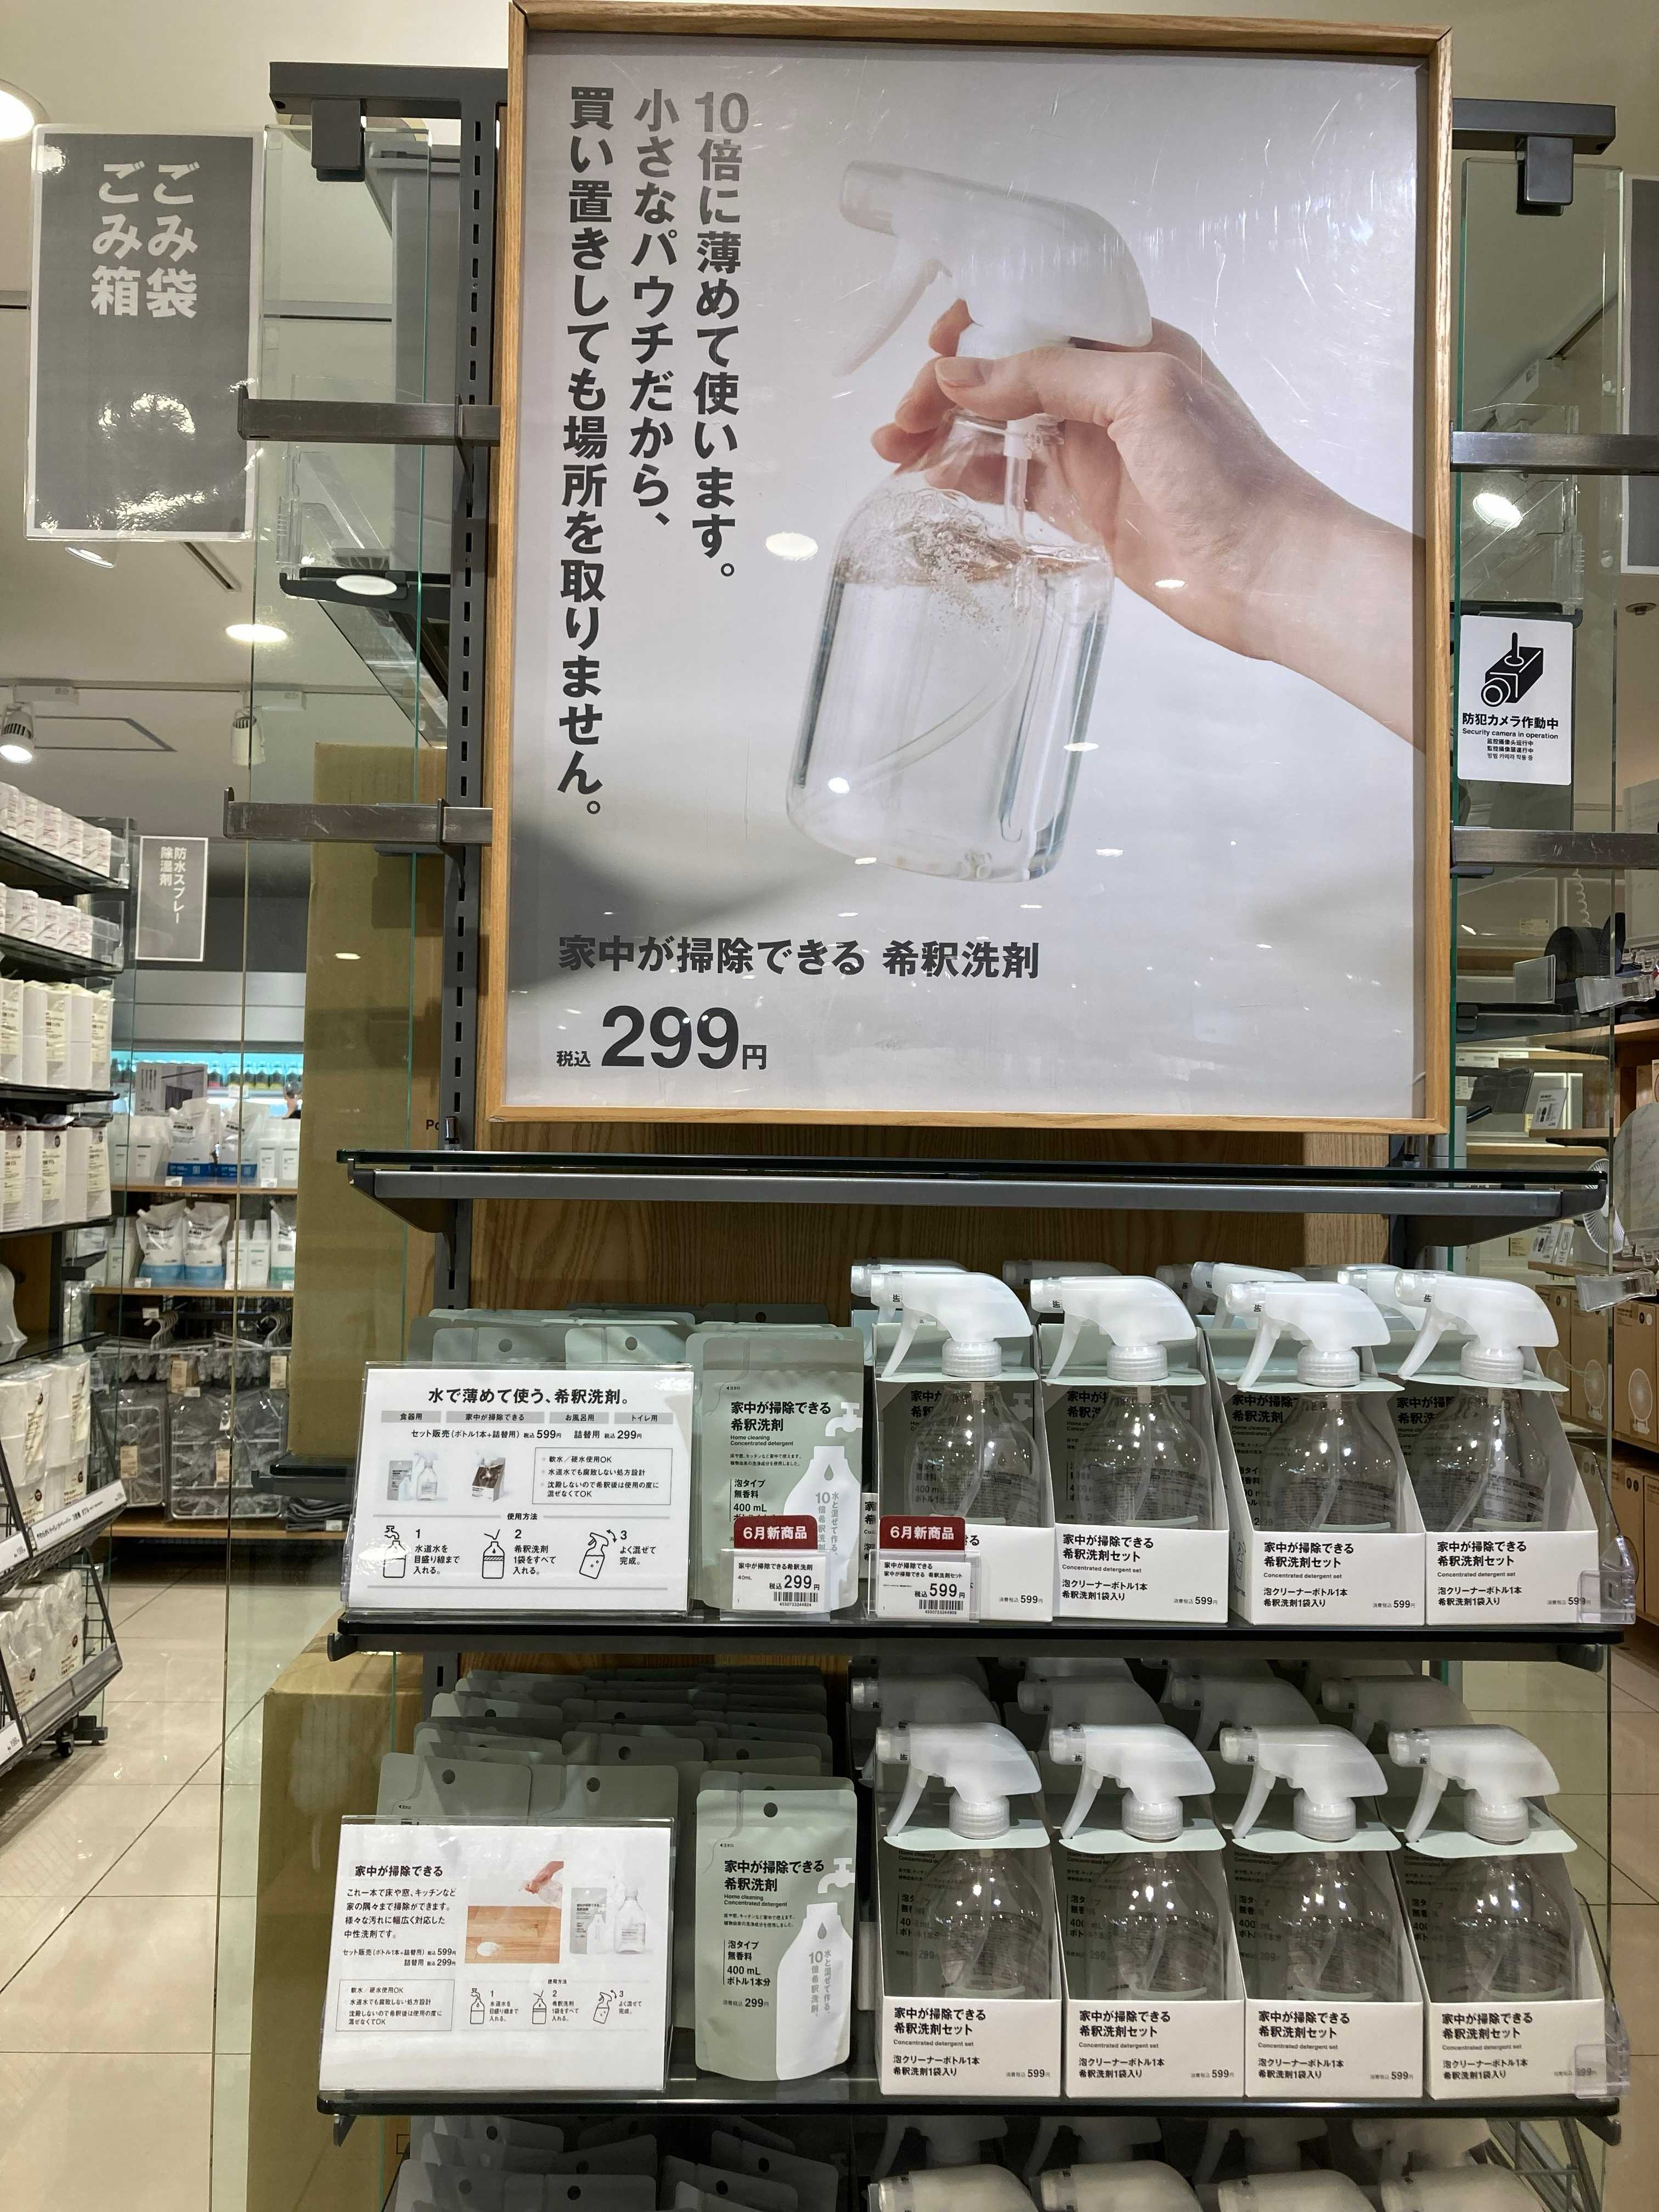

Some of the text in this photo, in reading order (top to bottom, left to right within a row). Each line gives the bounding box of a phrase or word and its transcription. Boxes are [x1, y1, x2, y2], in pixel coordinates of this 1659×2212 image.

[91, 160, 144, 317] ごみ箱
[146, 161, 199, 318] ごみ袋
[629, 88, 680, 525] 小さなパウチだから、
[692, 91, 749, 577] 10倍に薄めて使います。
[557, 86, 614, 815] 買い置きしても場所を取りません。
[1462, 713, 1559, 730] 防犯カメラ作動中
[1462, 728, 1490, 736] Security
[1526, 732, 1559, 740] operation
[159, 847, 174, 886] 除湿剤
[173, 847, 187, 924] 防水スプレー
[559, 935, 1039, 979] 家中が掃除できる 希釈洗剤
[556, 1006, 767, 1070] 税込 299円
[428, 1388, 629, 1404] 水で薄めて使う、希釈洗剤。
[731, 1401, 831, 1415] 家中が掃除できる
[399, 1413, 422, 1421] 食器用
[565, 1414, 595, 1422] お風呂用
[631, 1414, 658, 1423] トイレ用
[731, 1419, 783, 1432] 希釈洗剤
[537, 1429, 562, 1440] 599円
[574, 1430, 600, 1439] 詰替用
[617, 1430, 642, 1440] 299円
[735, 1479, 765, 1488] 泡タイプ
[734, 1490, 758, 1498] 無香料
[753, 1504, 767, 1512] mL
[507, 1513, 538, 1521] 使用方法
[415, 1529, 421, 1539] 1
[515, 1530, 522, 1539] 2
[620, 1530, 627, 1540] 3
[743, 1526, 808, 1540] 6月新商品
[890, 1526, 954, 1541] 6月新商品
[1062, 1533, 1154, 1549] 家中が掃除できる
[1437, 1540, 1527, 1553] 家中が掃除できる
[415, 1544, 448, 1553] 水道水を
[514, 1545, 549, 1554] 希釈洗剤
[620, 1545, 656, 1554] よく混ぜて
[1263, 1541, 1355, 1555] 家中が掃除できる
[414, 1555, 460, 1564] 目盛り線まで
[514, 1556, 556, 1564] 1袋をすべて
[619, 1556, 641, 1565] 完成。
[1063, 1548, 1141, 1562] 希釈洗剤セット
[738, 1562, 813, 1571] 家中が掃除できる希釈洗剤
[1263, 1555, 1342, 1568] 希釈洗剤セット
[1437, 1555, 1515, 1567] 希釈洗剤セット
[413, 1566, 441, 1575] 入れる。
[512, 1566, 540, 1576] 入れる。
[1062, 1578, 1148, 1591] 泡クリーナーボトル1本
[1062, 1590, 1125, 1601] 希釈洗剤1袋入り
[1263, 1587, 1347, 1598] 泡クリーナーボトル1本
[1020, 1595, 1043, 1604] 599円
[1263, 1598, 1325, 1608] 希釈洗剤1袋入り
[355, 1865, 443, 1877] 家中が掃除できる
[724, 1860, 824, 1874] 家中が掃除できる
[724, 1877, 777, 1892] 希釈洗剤
[345, 1916, 445, 1925] 様々な汚れに幅広く対応した
[344, 1929, 396, 1939] 中性洗剤です。
[728, 1940, 759, 1949] 泡タイプ
[728, 1951, 752, 1961] 無香料
[727, 1966, 760, 1975] 400 mL
[727, 1977, 771, 1987] ボトル1本分
[745, 1998, 769, 2007] 299円
[894, 2007, 986, 2021] 家中が掃除できる
[894, 2023, 973, 2037] 希釈洗剤セット
